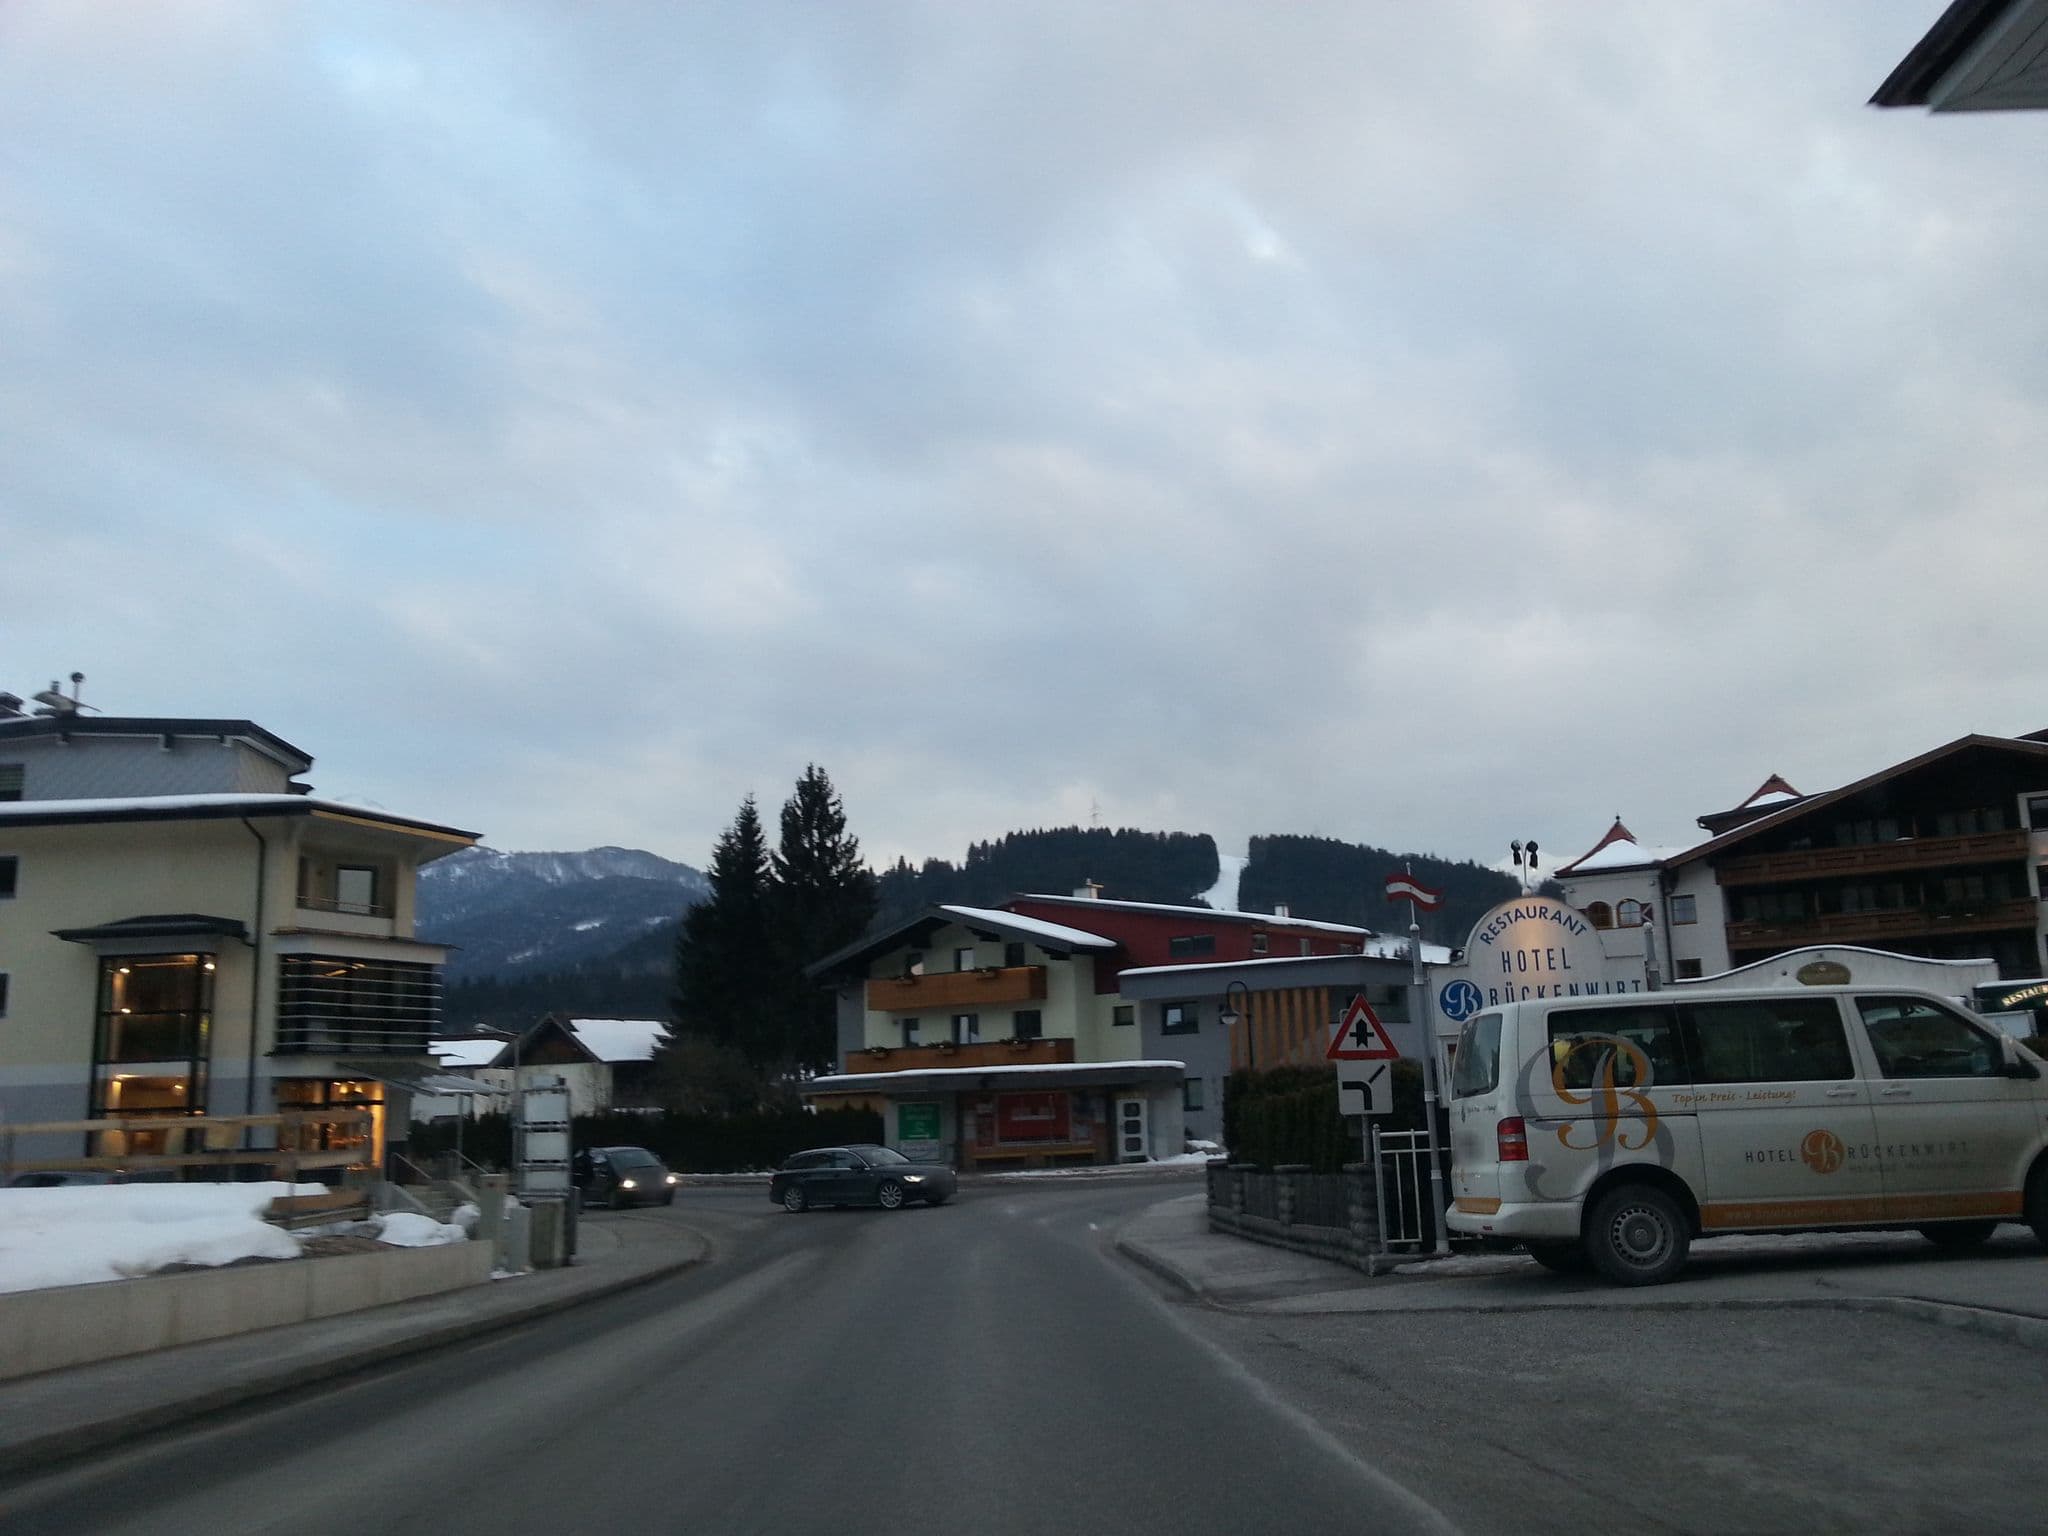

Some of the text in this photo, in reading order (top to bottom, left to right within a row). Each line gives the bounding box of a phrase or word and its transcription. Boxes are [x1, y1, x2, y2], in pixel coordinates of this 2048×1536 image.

[1480, 905, 1588, 945] RESTAURANT
[1502, 947, 1571, 974] HOTEL
[1745, 1150, 1796, 1163] HOTEL
